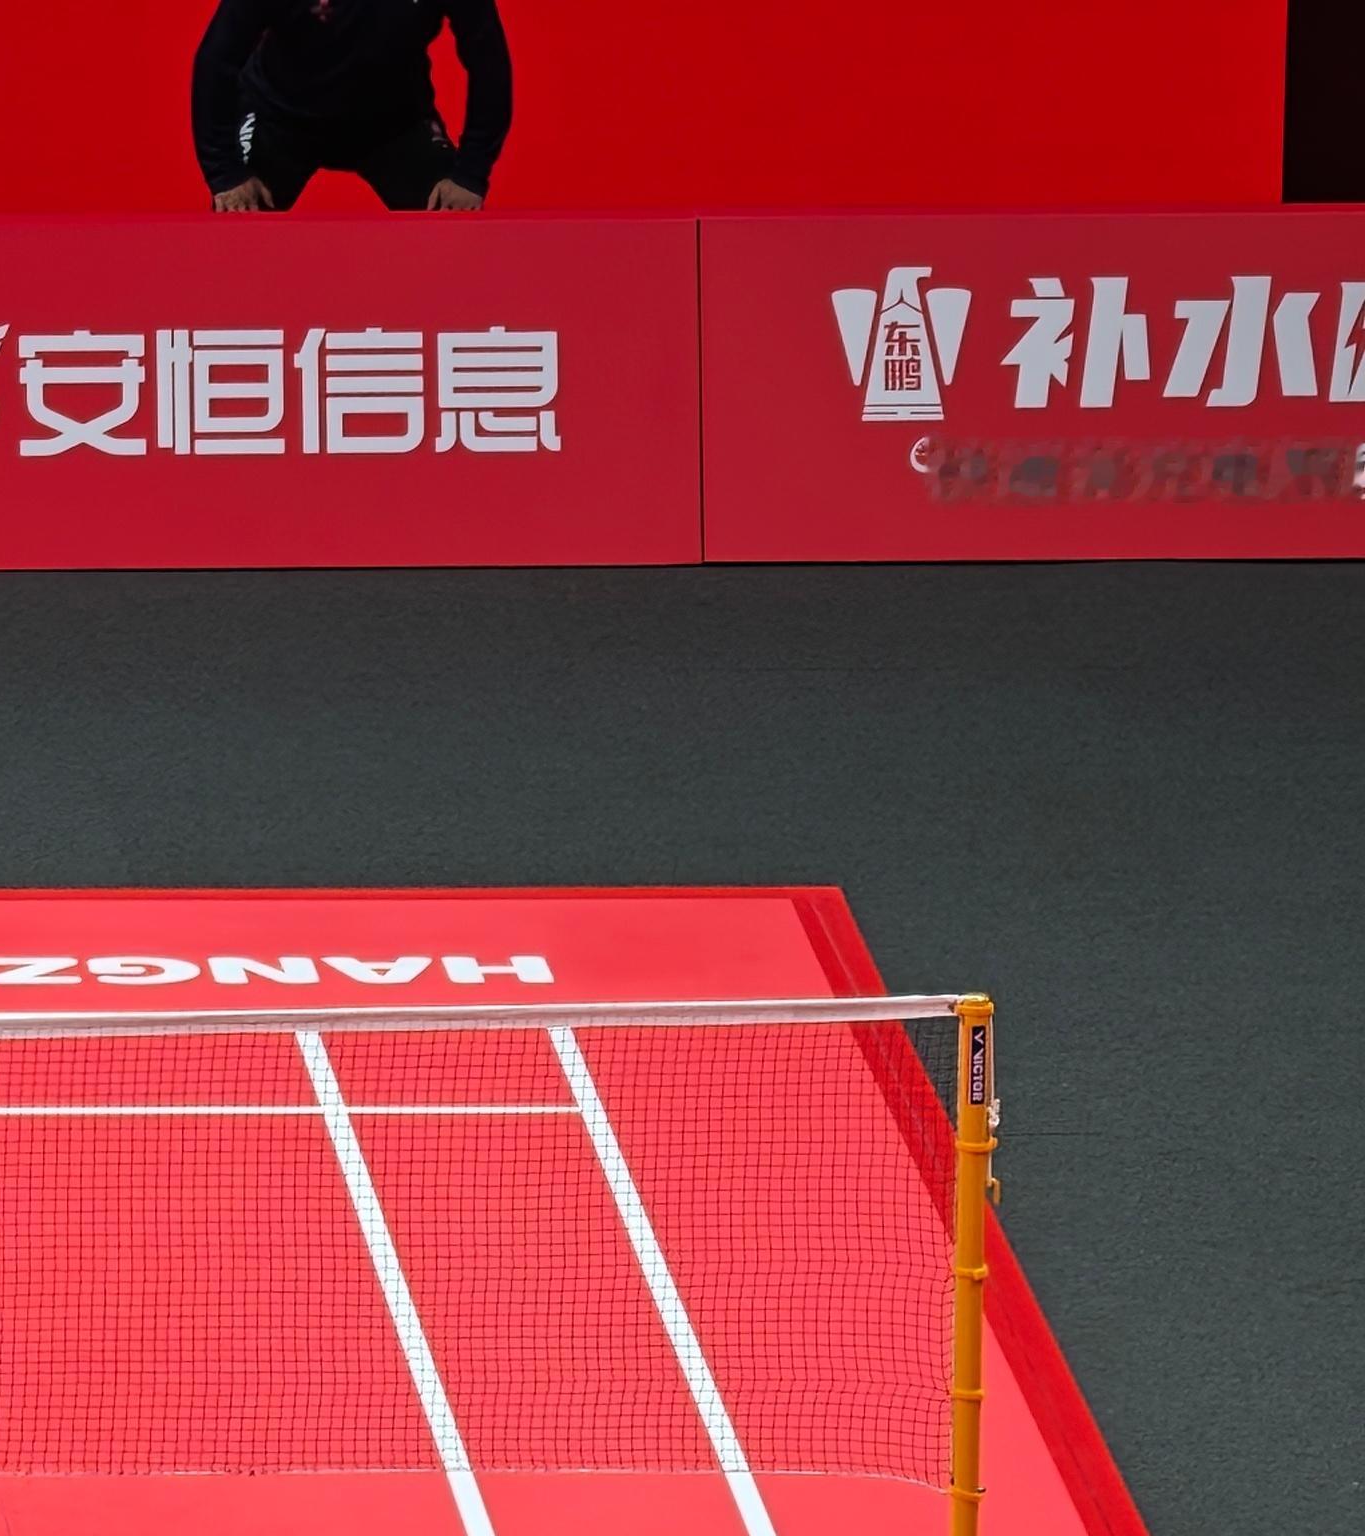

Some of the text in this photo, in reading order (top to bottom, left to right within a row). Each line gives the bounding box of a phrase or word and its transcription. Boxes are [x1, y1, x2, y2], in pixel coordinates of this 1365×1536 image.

[18, 325, 562, 457] 安恒信息
[884, 320, 921, 391] 东鹏
[1000, 276, 1365, 409] 补水
[972, 1047, 985, 1102] VICTOR
